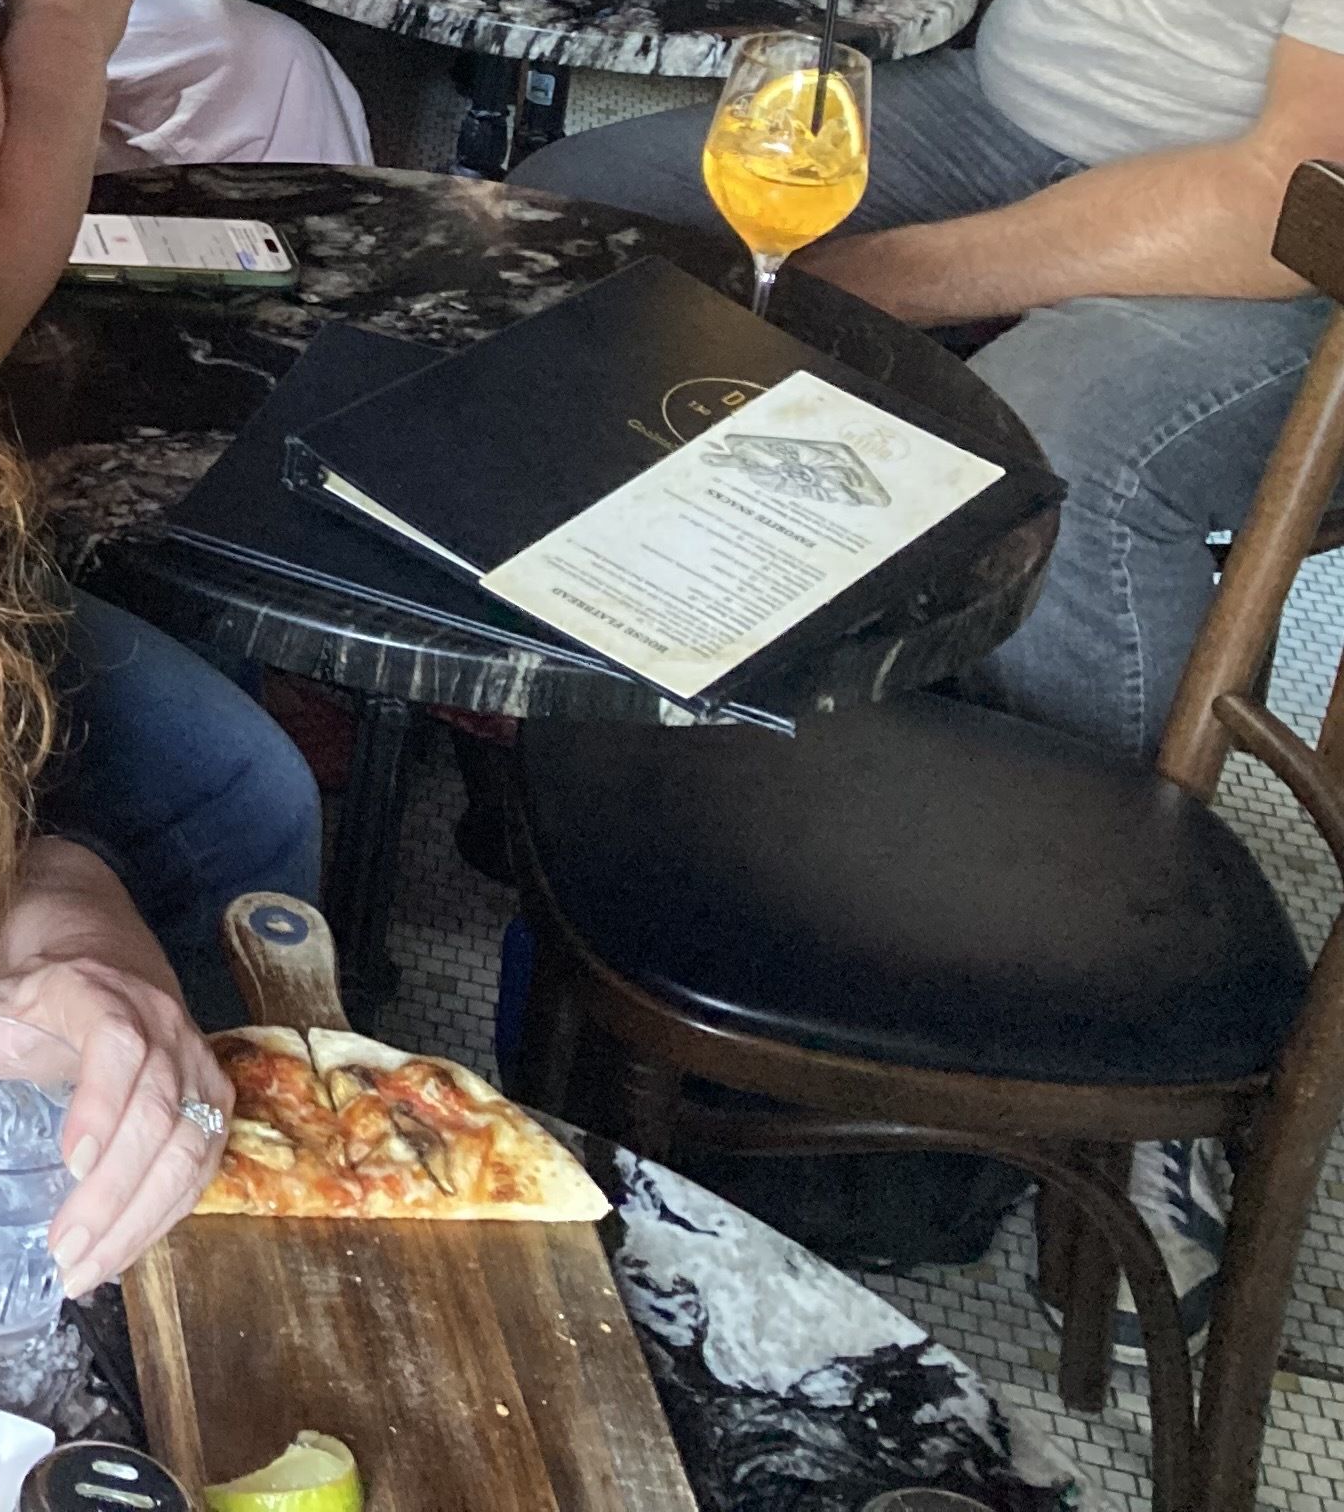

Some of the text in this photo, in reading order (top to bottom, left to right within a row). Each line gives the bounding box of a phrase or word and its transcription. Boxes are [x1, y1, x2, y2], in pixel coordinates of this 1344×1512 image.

[706, 488, 754, 517] SNACKS
[753, 513, 817, 549] FAVORITE
[551, 586, 626, 630] FLATBREAD
[623, 626, 669, 655] HOUSE
